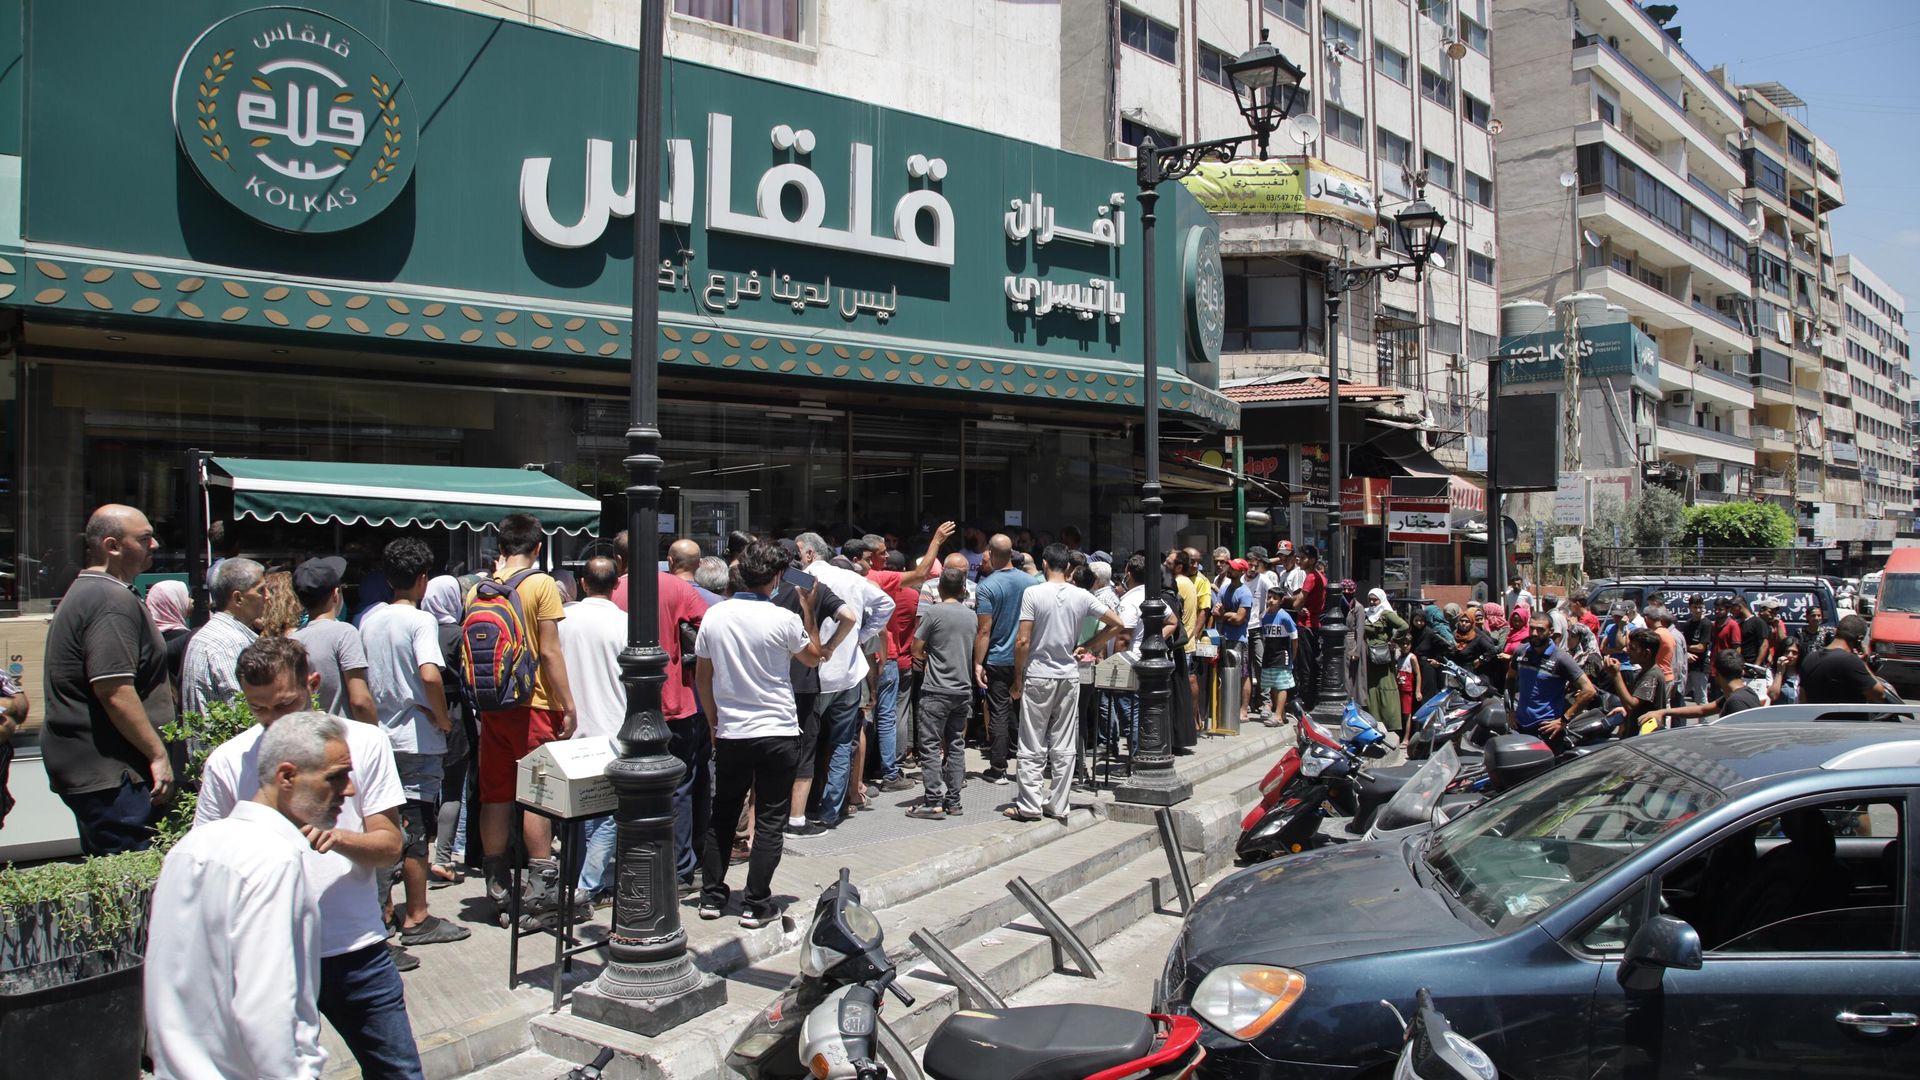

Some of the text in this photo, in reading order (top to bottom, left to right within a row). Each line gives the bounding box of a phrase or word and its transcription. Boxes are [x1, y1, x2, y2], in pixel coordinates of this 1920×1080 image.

[253, 21, 350, 58] قلقاس
[245, 175, 358, 213] KOLKAS
[520, 111, 955, 266] قلقاس
[1290, 194, 1302, 202] 767
[1005, 192, 1125, 247] أفران
[702, 269, 762, 312] فرع
[770, 267, 831, 310] لدينا
[838, 284, 898, 321] ليس
[1005, 276, 1125, 324] باتيسري
[1509, 339, 1593, 365] KOLKS
[1392, 513, 1446, 530] مختار
